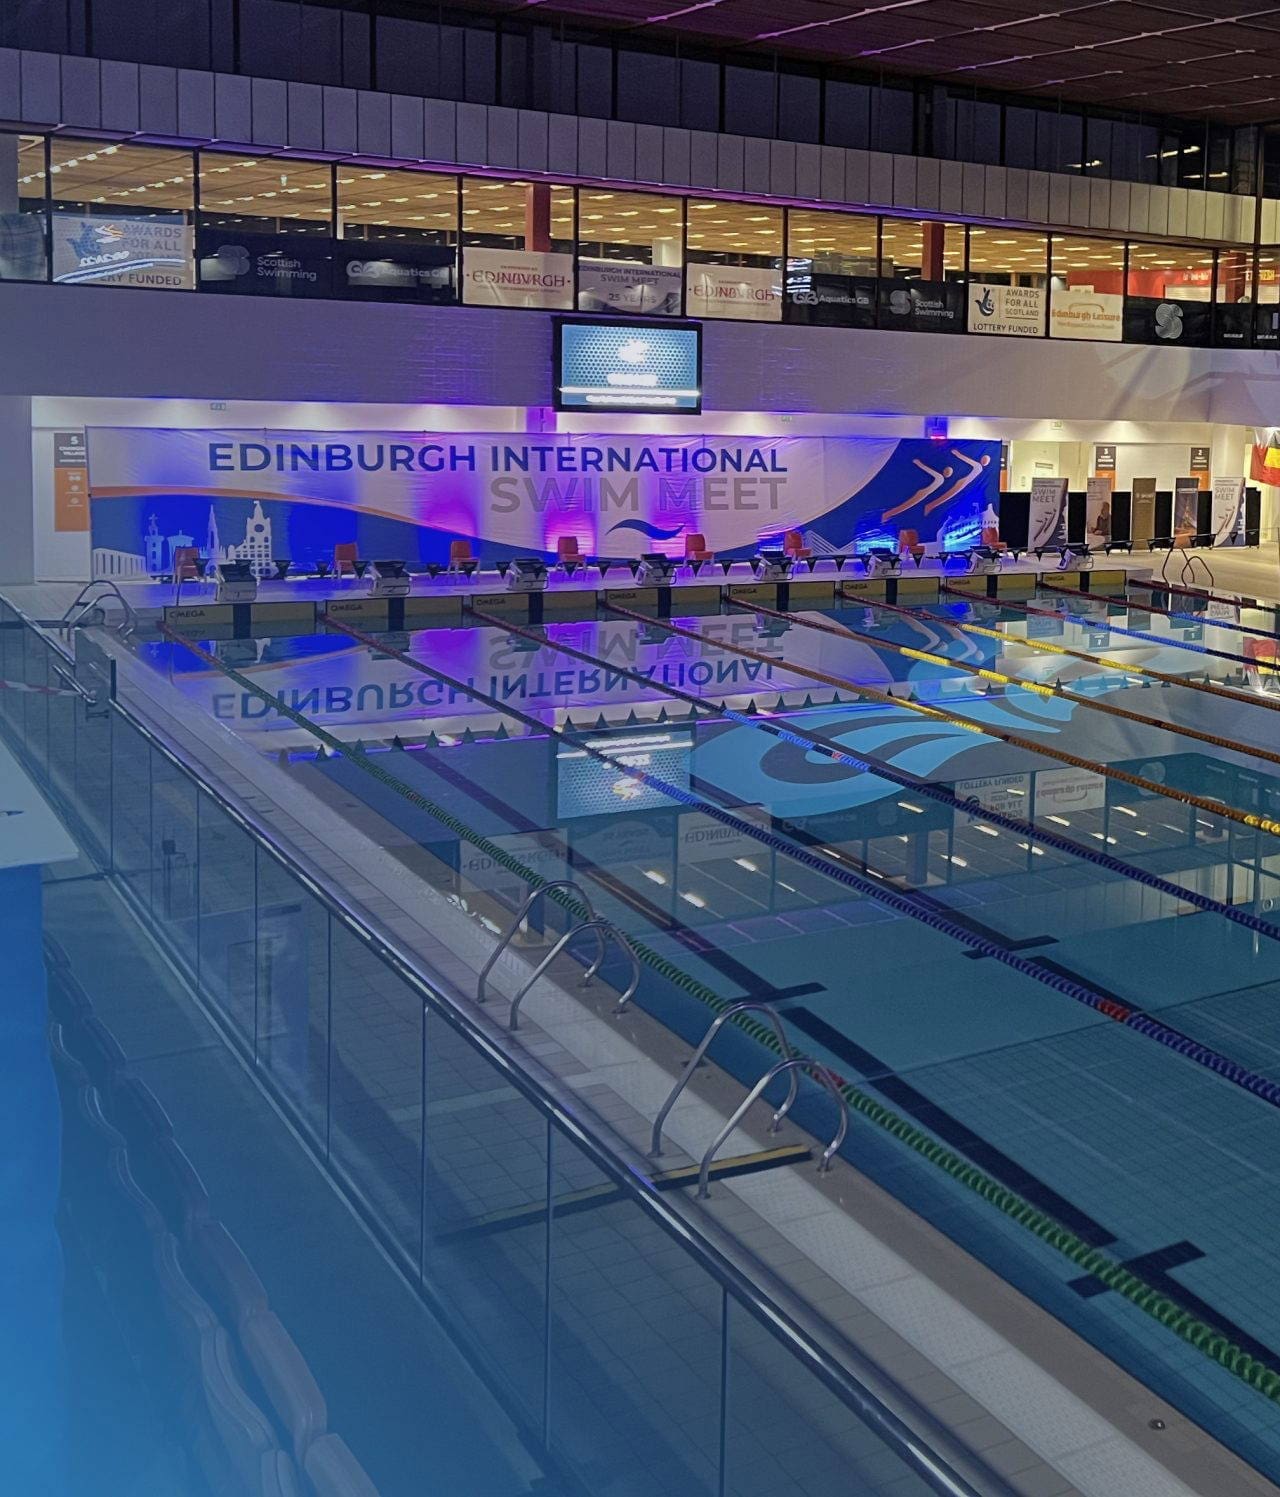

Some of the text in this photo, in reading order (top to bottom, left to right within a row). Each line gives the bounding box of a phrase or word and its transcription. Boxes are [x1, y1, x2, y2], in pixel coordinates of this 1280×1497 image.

[153, 240, 180, 252] ALL
[257, 256, 301, 269] Scottish
[128, 273, 182, 286] FUNDED
[257, 267, 317, 282] Swimming
[600, 274, 660, 286] SWIM MEET
[819, 294, 856, 304] Aquatics
[1006, 288, 1040, 298] AWARDS
[915, 299, 944, 309] Scottish
[1005, 298, 1039, 309] FOR ALL
[915, 307, 954, 319] Swimming
[1005, 308, 1039, 317] SCOTLAND
[973, 322, 1039, 334] LOTTERY FUNDED
[209, 442, 788, 473] EDINBURGH INTERNATIONAL
[490, 476, 788, 513] SWIM MEET
